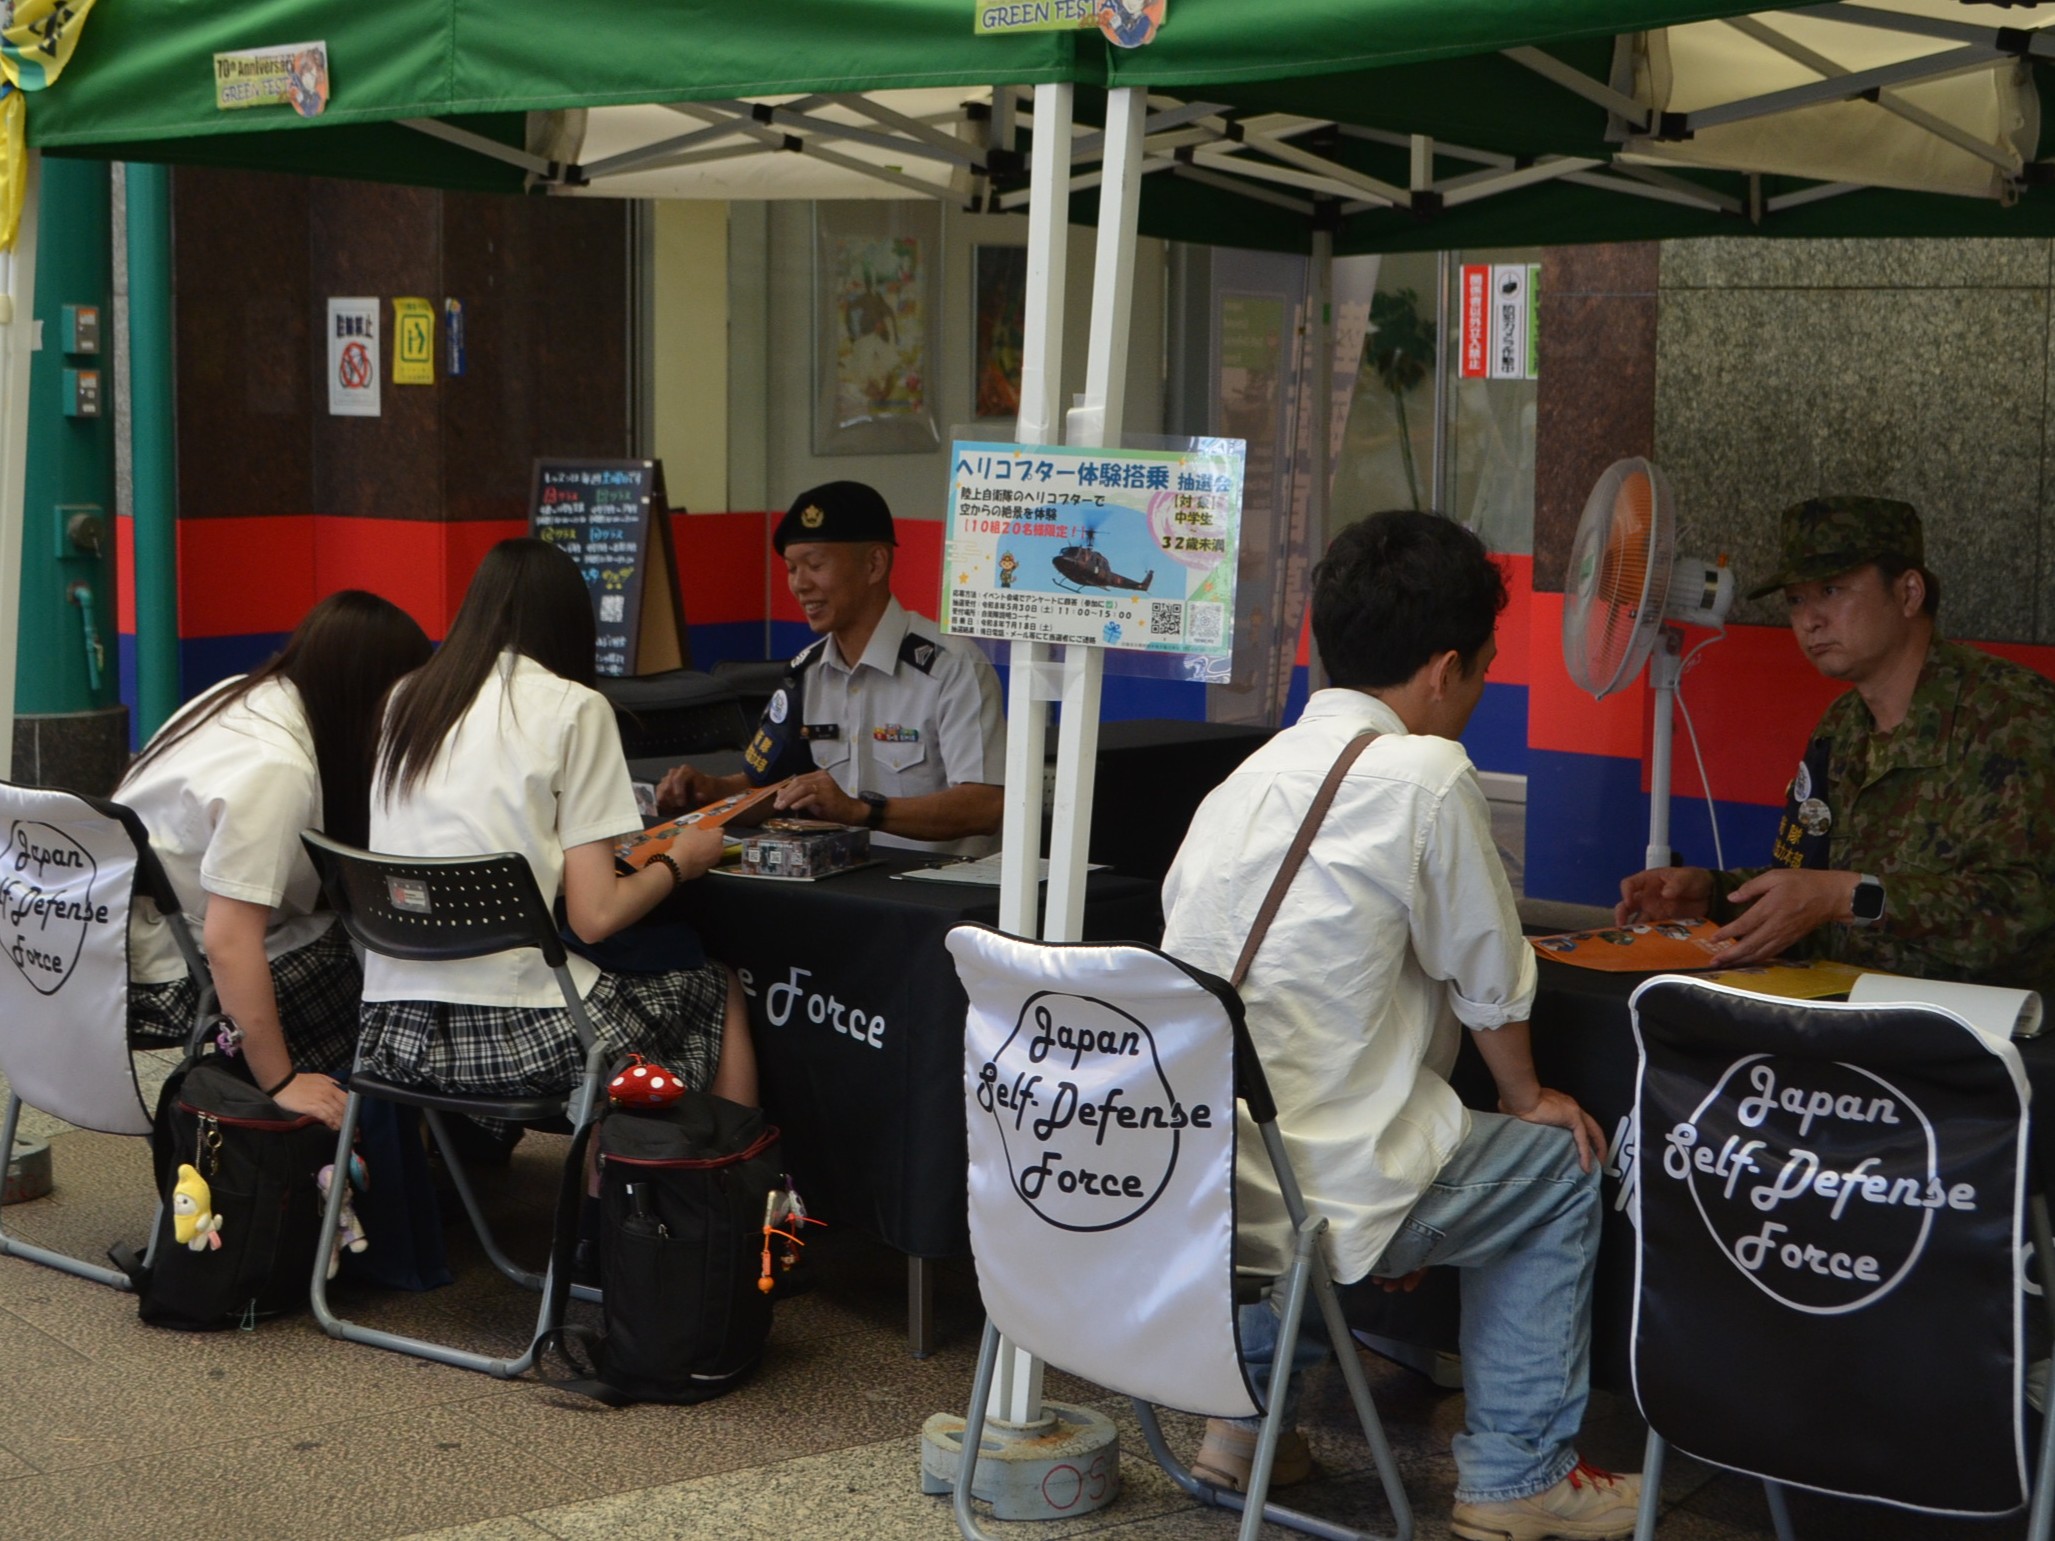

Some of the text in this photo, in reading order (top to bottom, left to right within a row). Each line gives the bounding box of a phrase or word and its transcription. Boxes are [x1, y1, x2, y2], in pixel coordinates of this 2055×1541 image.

[982, 0, 1118, 29] GREEN FESTA
[238, 57, 295, 77] Anniversary
[222, 82, 260, 103] GREEN
[956, 457, 1169, 490] ヘリコプター体験搭乗
[959, 503, 1058, 521] 空からの絶景を体験
[960, 487, 1106, 507] 陸上自衛隊のヘリコプターで
[1175, 511, 1213, 526] 中学生
[1162, 536, 1225, 552] 32歳未満
[15, 829, 84, 877] Japan
[0, 877, 109, 932] lf-Defense
[12, 935, 63, 974] Force
[766, 966, 885, 1049] Force
[1029, 1005, 1140, 1070] Japan
[1737, 1065, 1900, 1137] Japan
[1020, 1151, 1145, 1200] Force
[1735, 1221, 1881, 1282] Force
